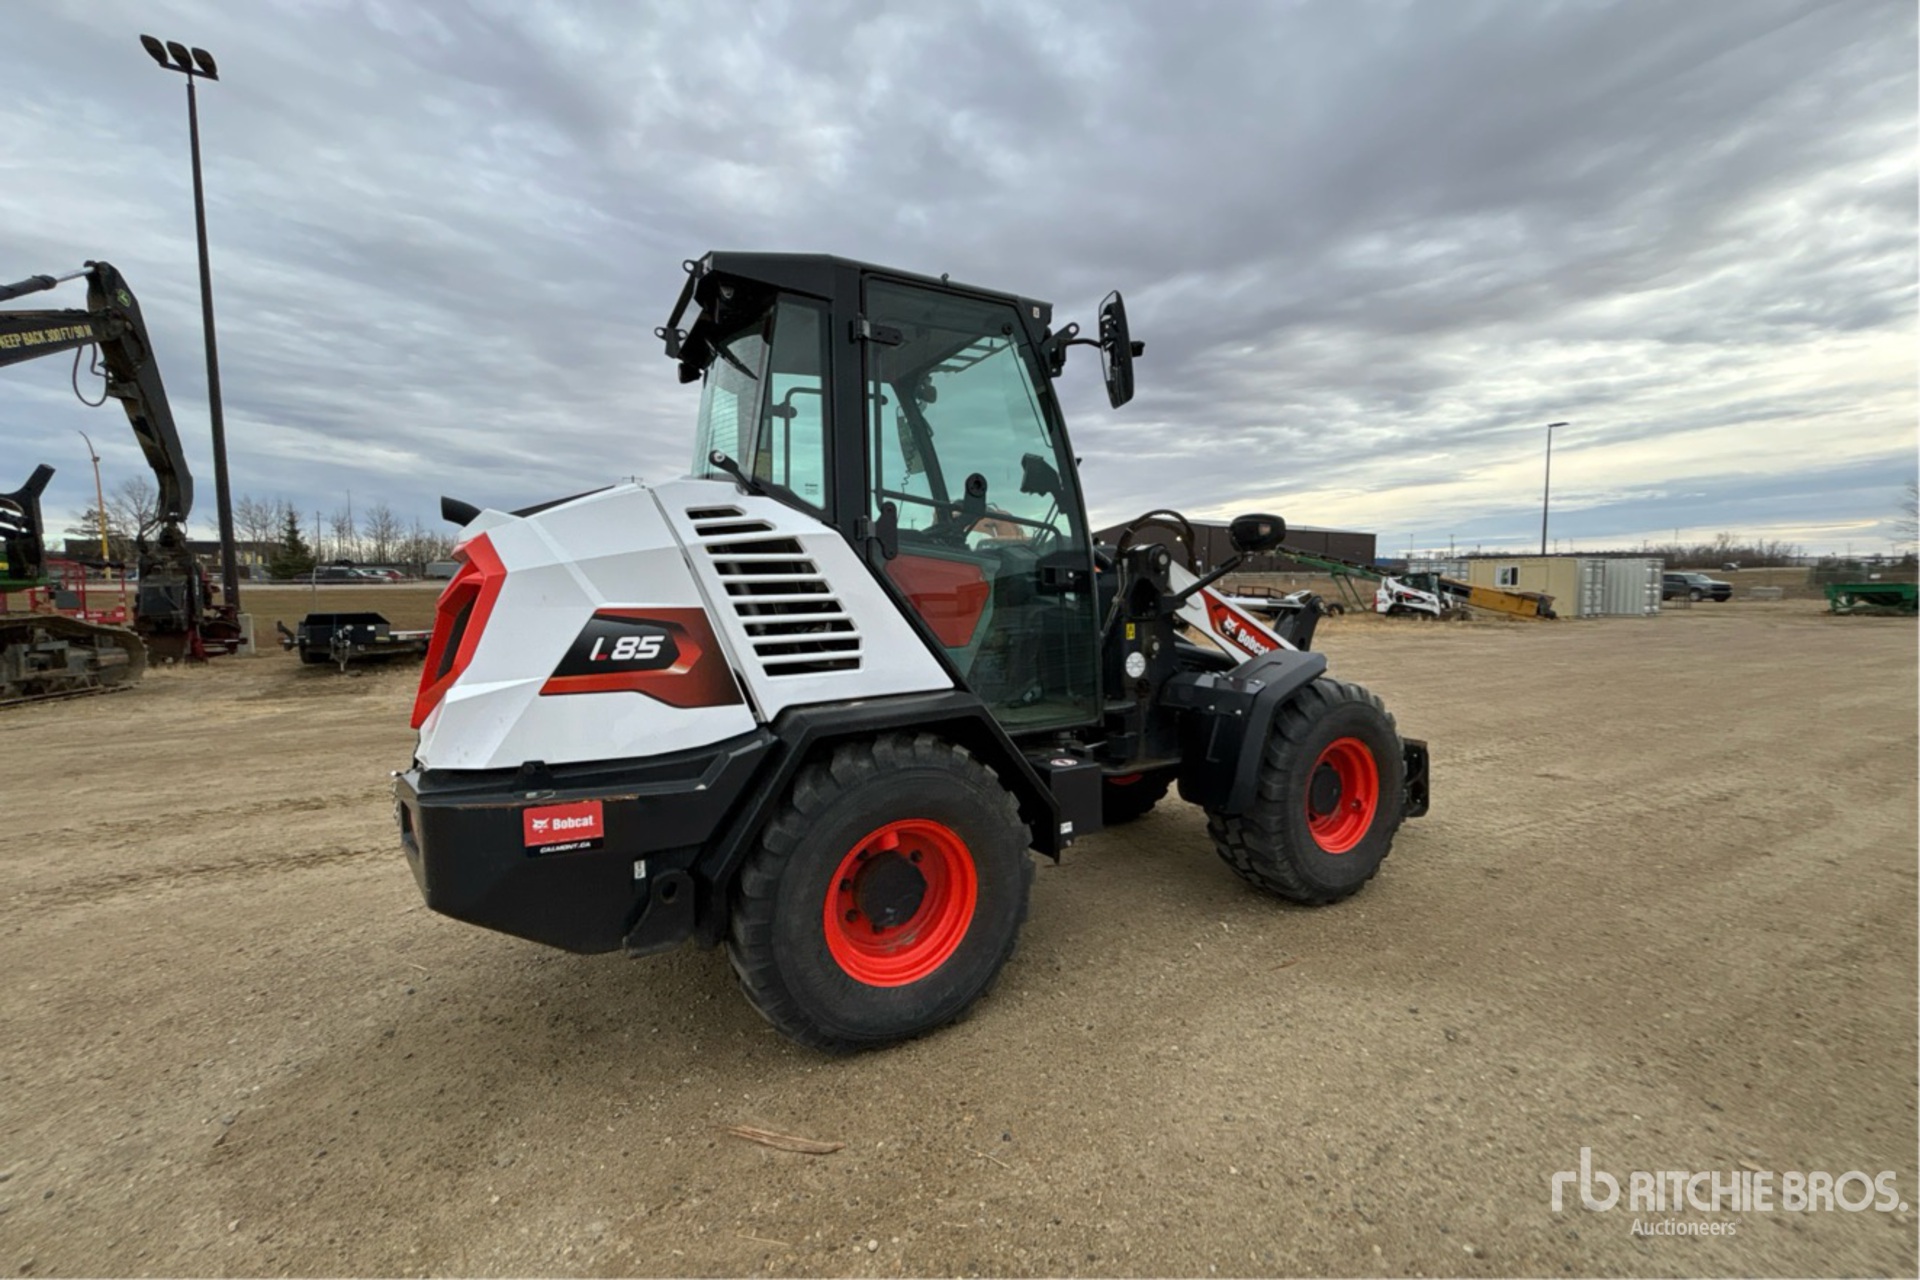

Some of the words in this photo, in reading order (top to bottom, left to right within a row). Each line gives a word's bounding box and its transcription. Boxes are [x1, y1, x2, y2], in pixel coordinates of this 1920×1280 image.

[21, 330, 46, 345] BACK
[552, 815, 594, 830] Bobcat
[540, 842, 591, 854] CALMONT.CA
